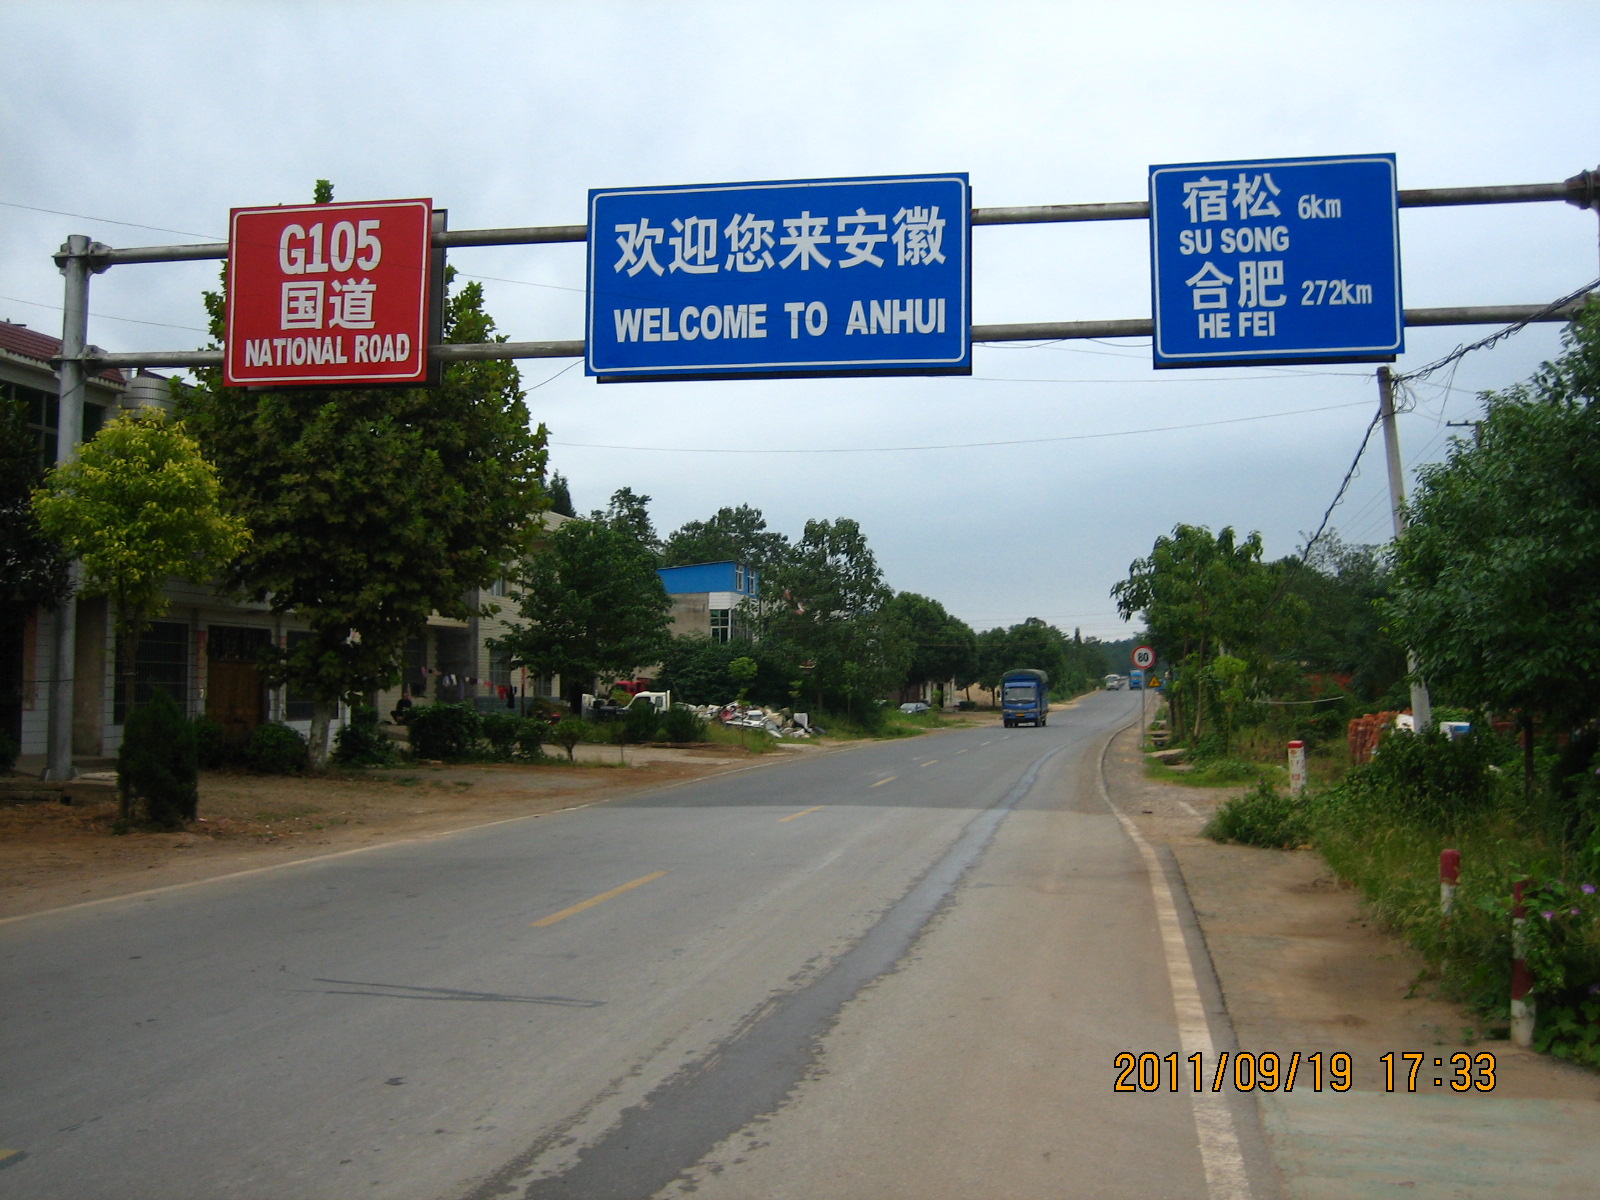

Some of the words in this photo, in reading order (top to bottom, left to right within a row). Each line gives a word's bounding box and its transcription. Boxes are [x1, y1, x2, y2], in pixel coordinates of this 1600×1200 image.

[1182, 173, 1281, 223] 宿松
[1297, 194, 1342, 220] 6km
[279, 219, 382, 275] G105
[613, 205, 947, 278] 欢迎您来安徽
[1179, 228, 1213, 255] SU
[1220, 225, 1290, 253] SONG
[280, 277, 377, 331] 国道
[1185, 260, 1287, 310] 合肥
[1301, 279, 1373, 306] 272km
[613, 303, 768, 343] WELCOME
[784, 300, 828, 339] TO
[845, 298, 946, 336] ANHUI
[1198, 312, 1231, 339] HE
[1238, 311, 1276, 337] FEI
[245, 335, 348, 367] NATIONAL
[354, 333, 410, 364] ROAD
[1137, 652, 1149, 663] 80
